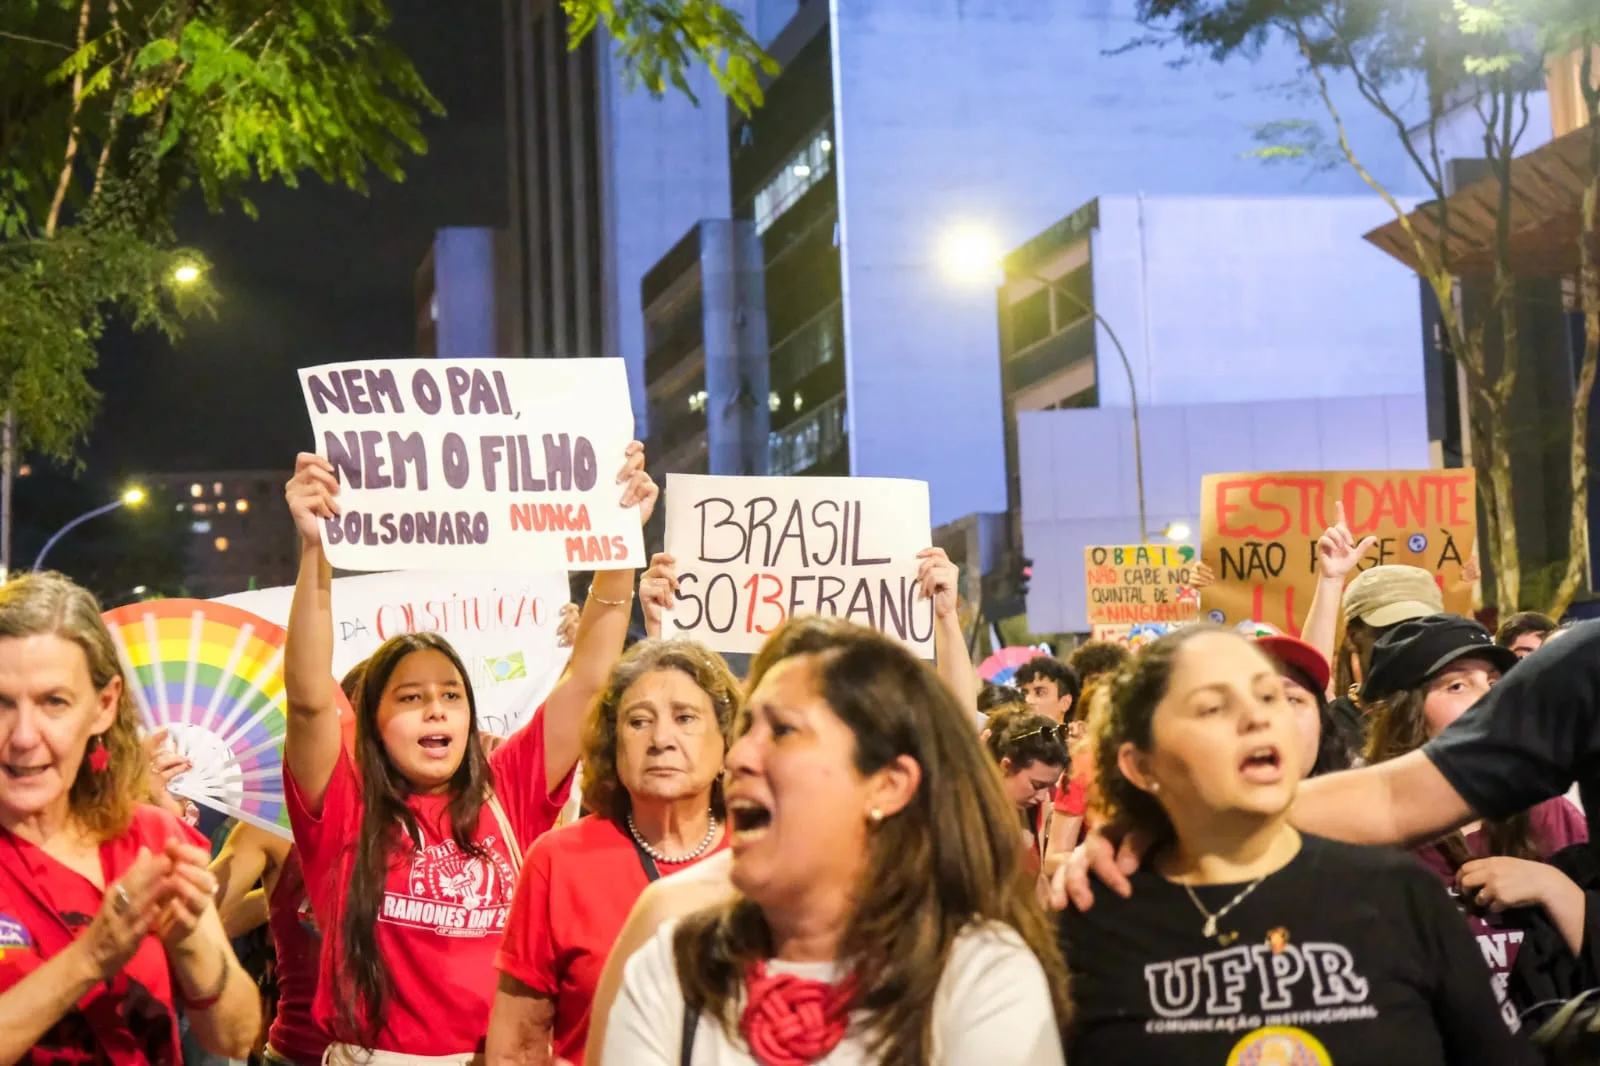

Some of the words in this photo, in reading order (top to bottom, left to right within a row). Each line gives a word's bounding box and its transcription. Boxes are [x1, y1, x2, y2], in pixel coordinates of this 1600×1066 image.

[307, 368, 405, 415] NEM
[411, 368, 442, 416] O
[445, 366, 521, 420] PAI,
[324, 430, 429, 491] NEM
[442, 432, 470, 490] O
[479, 432, 598, 493] FILHO
[325, 510, 490, 546] BOLSONARO
[510, 503, 592, 532] NUNCA
[1216, 475, 1471, 538] ESTUDANTE
[565, 535, 628, 563] MAIS
[694, 496, 892, 568] BRASIL
[1091, 547, 1107, 566] O
[1220, 541, 1287, 581] NÃO
[1436, 529, 1463, 569] À
[1087, 566, 1118, 585] NÃO
[1124, 568, 1161, 585] CABE
[1167, 568, 1191, 585] NO
[1091, 587, 1146, 605] QUINTAL
[1153, 588, 1168, 604] DE
[340, 617, 369, 642] DA
[384, 896, 466, 928] RAMONES
[467, 908, 496, 929] DAY
[495, 910, 507, 928] 2
[1144, 942, 1368, 1017] UFPR
[1145, 1013, 1261, 1033] COMUNICAÇÃO
[1264, 1004, 1378, 1027] INSTITUCIONAL
